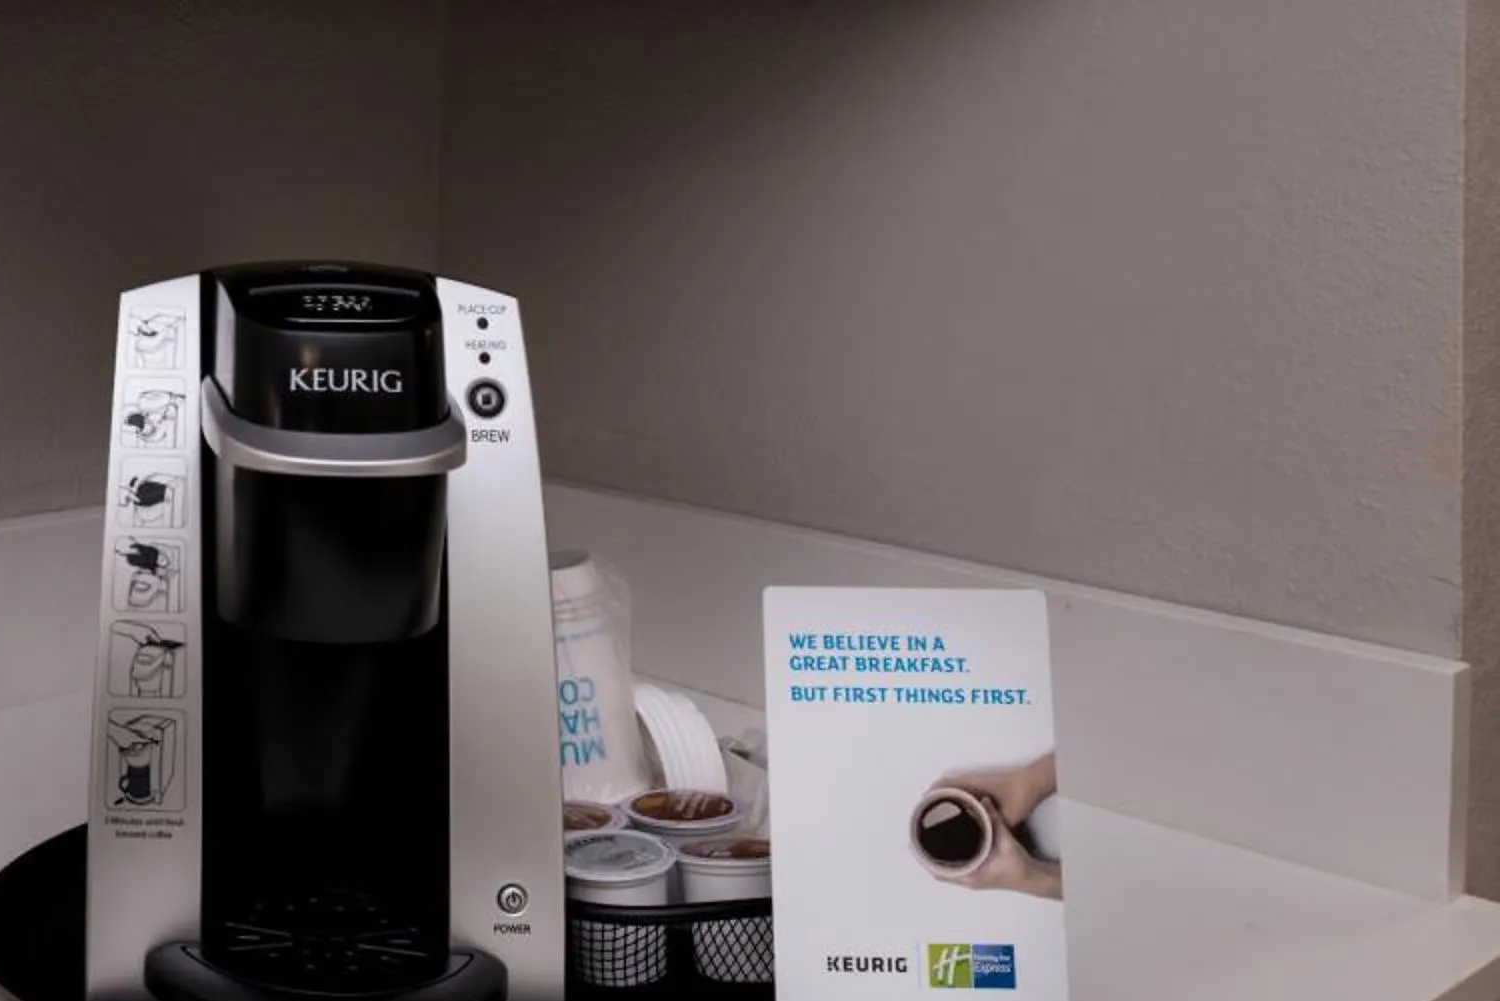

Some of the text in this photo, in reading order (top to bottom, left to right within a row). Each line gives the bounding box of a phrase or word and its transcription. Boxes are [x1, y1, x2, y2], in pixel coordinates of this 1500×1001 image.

[289, 367, 403, 394] KEURIG
[471, 428, 511, 443] BREW
[788, 634, 946, 652] WE BELIEVE IN A
[789, 655, 971, 673] GREAT BREAKFAST.
[559, 675, 596, 705] CO
[790, 686, 1032, 705] BUT FIRST THINGS FIRST.
[561, 706, 602, 735] HA
[560, 735, 608, 767] MU
[493, 923, 532, 936] POWER
[827, 956, 908, 973] KEURIG
[974, 961, 1012, 975] Express
